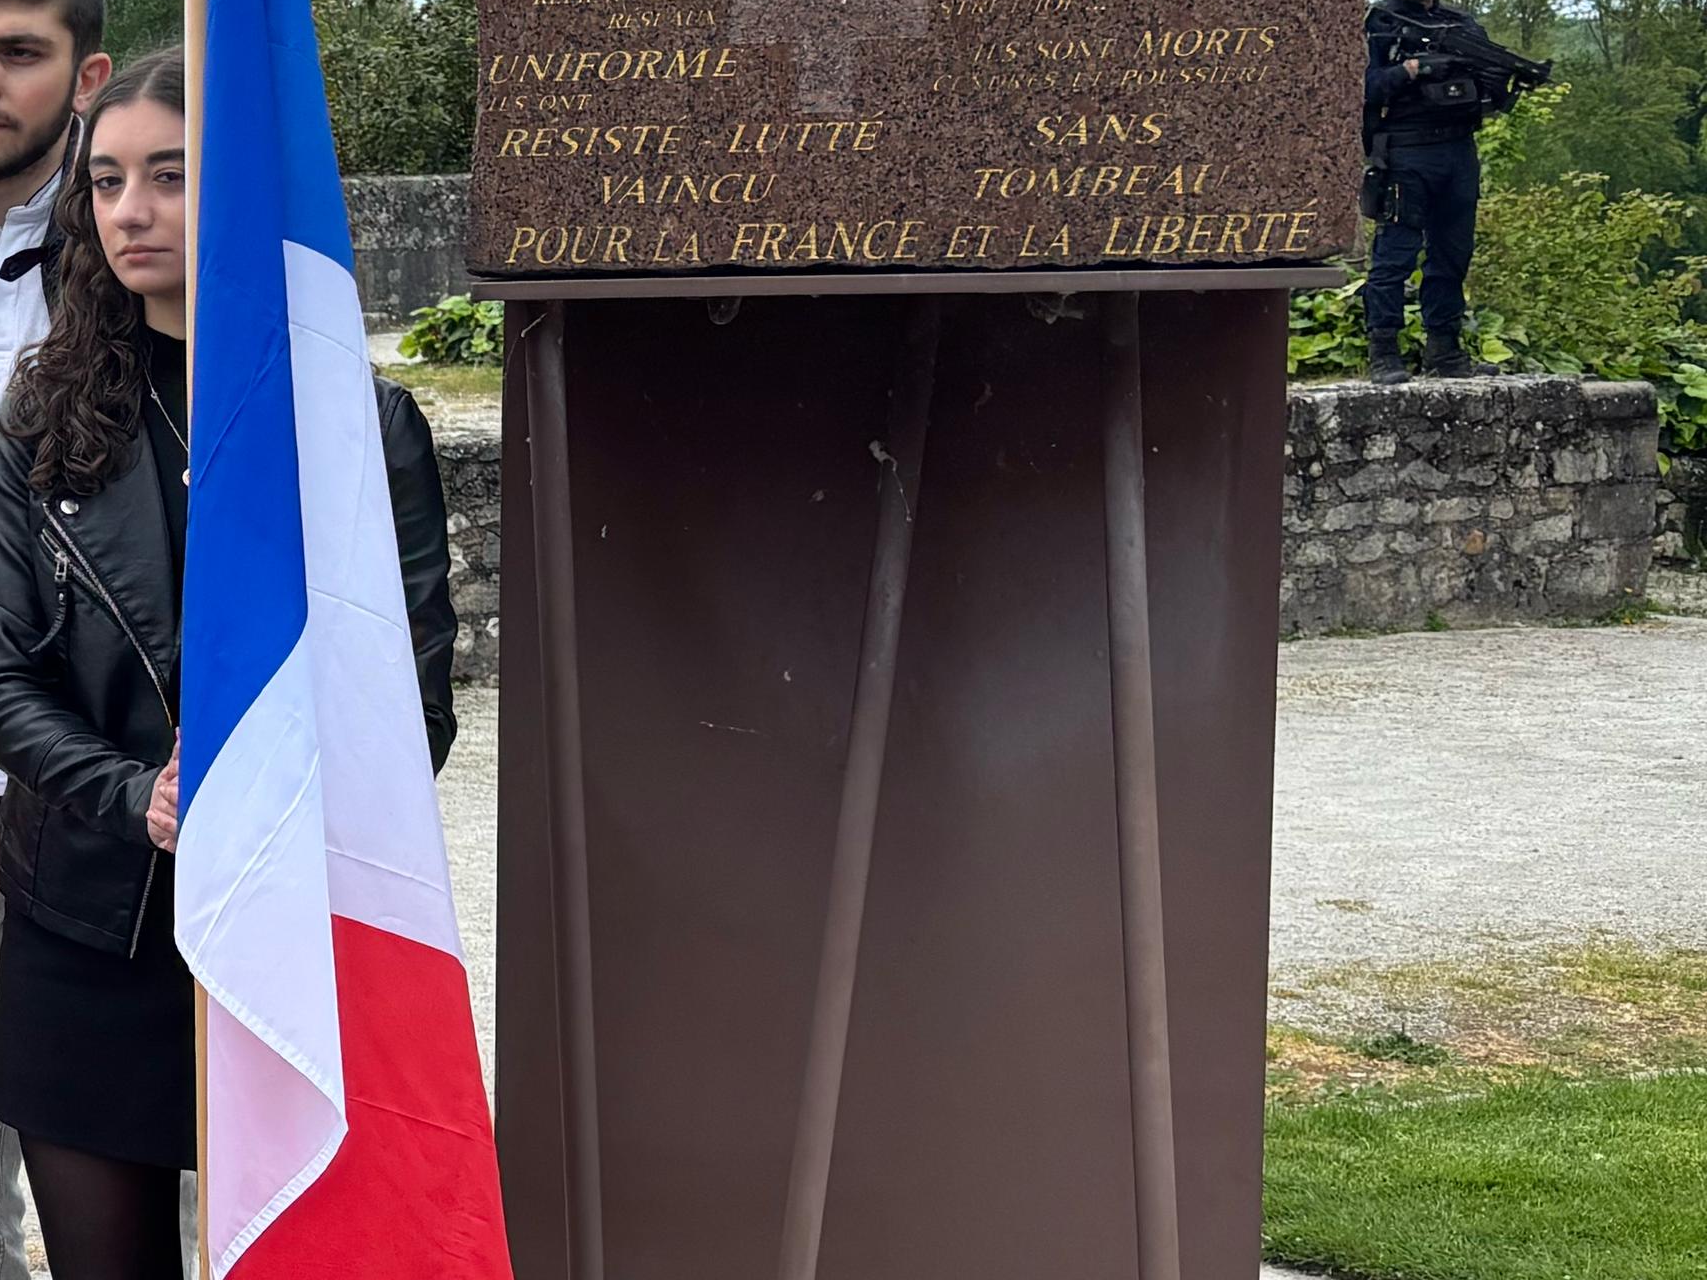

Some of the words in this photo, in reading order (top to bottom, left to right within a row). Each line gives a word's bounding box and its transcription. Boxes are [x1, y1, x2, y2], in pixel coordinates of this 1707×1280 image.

[972, 39, 1017, 64] ILS
[1036, 37, 1118, 63] SONT
[1134, 25, 1280, 60] MORTS
[487, 47, 743, 85] UNIFORME
[489, 94, 528, 112] ILS
[539, 93, 593, 111] ONT
[496, 115, 689, 159] RÉSISTÉ
[728, 110, 886, 154] LUTTÉ
[1029, 111, 1173, 147] SANS
[600, 173, 780, 205] VAINCU
[973, 163, 1231, 200] TOMBEAU
[505, 224, 633, 265] POUR
[653, 226, 701, 263] LA
[730, 220, 926, 262] FRANCE
[946, 225, 1001, 259] ET
[1019, 223, 1071, 258] LA
[1101, 197, 1319, 257] LIBERTÉ
